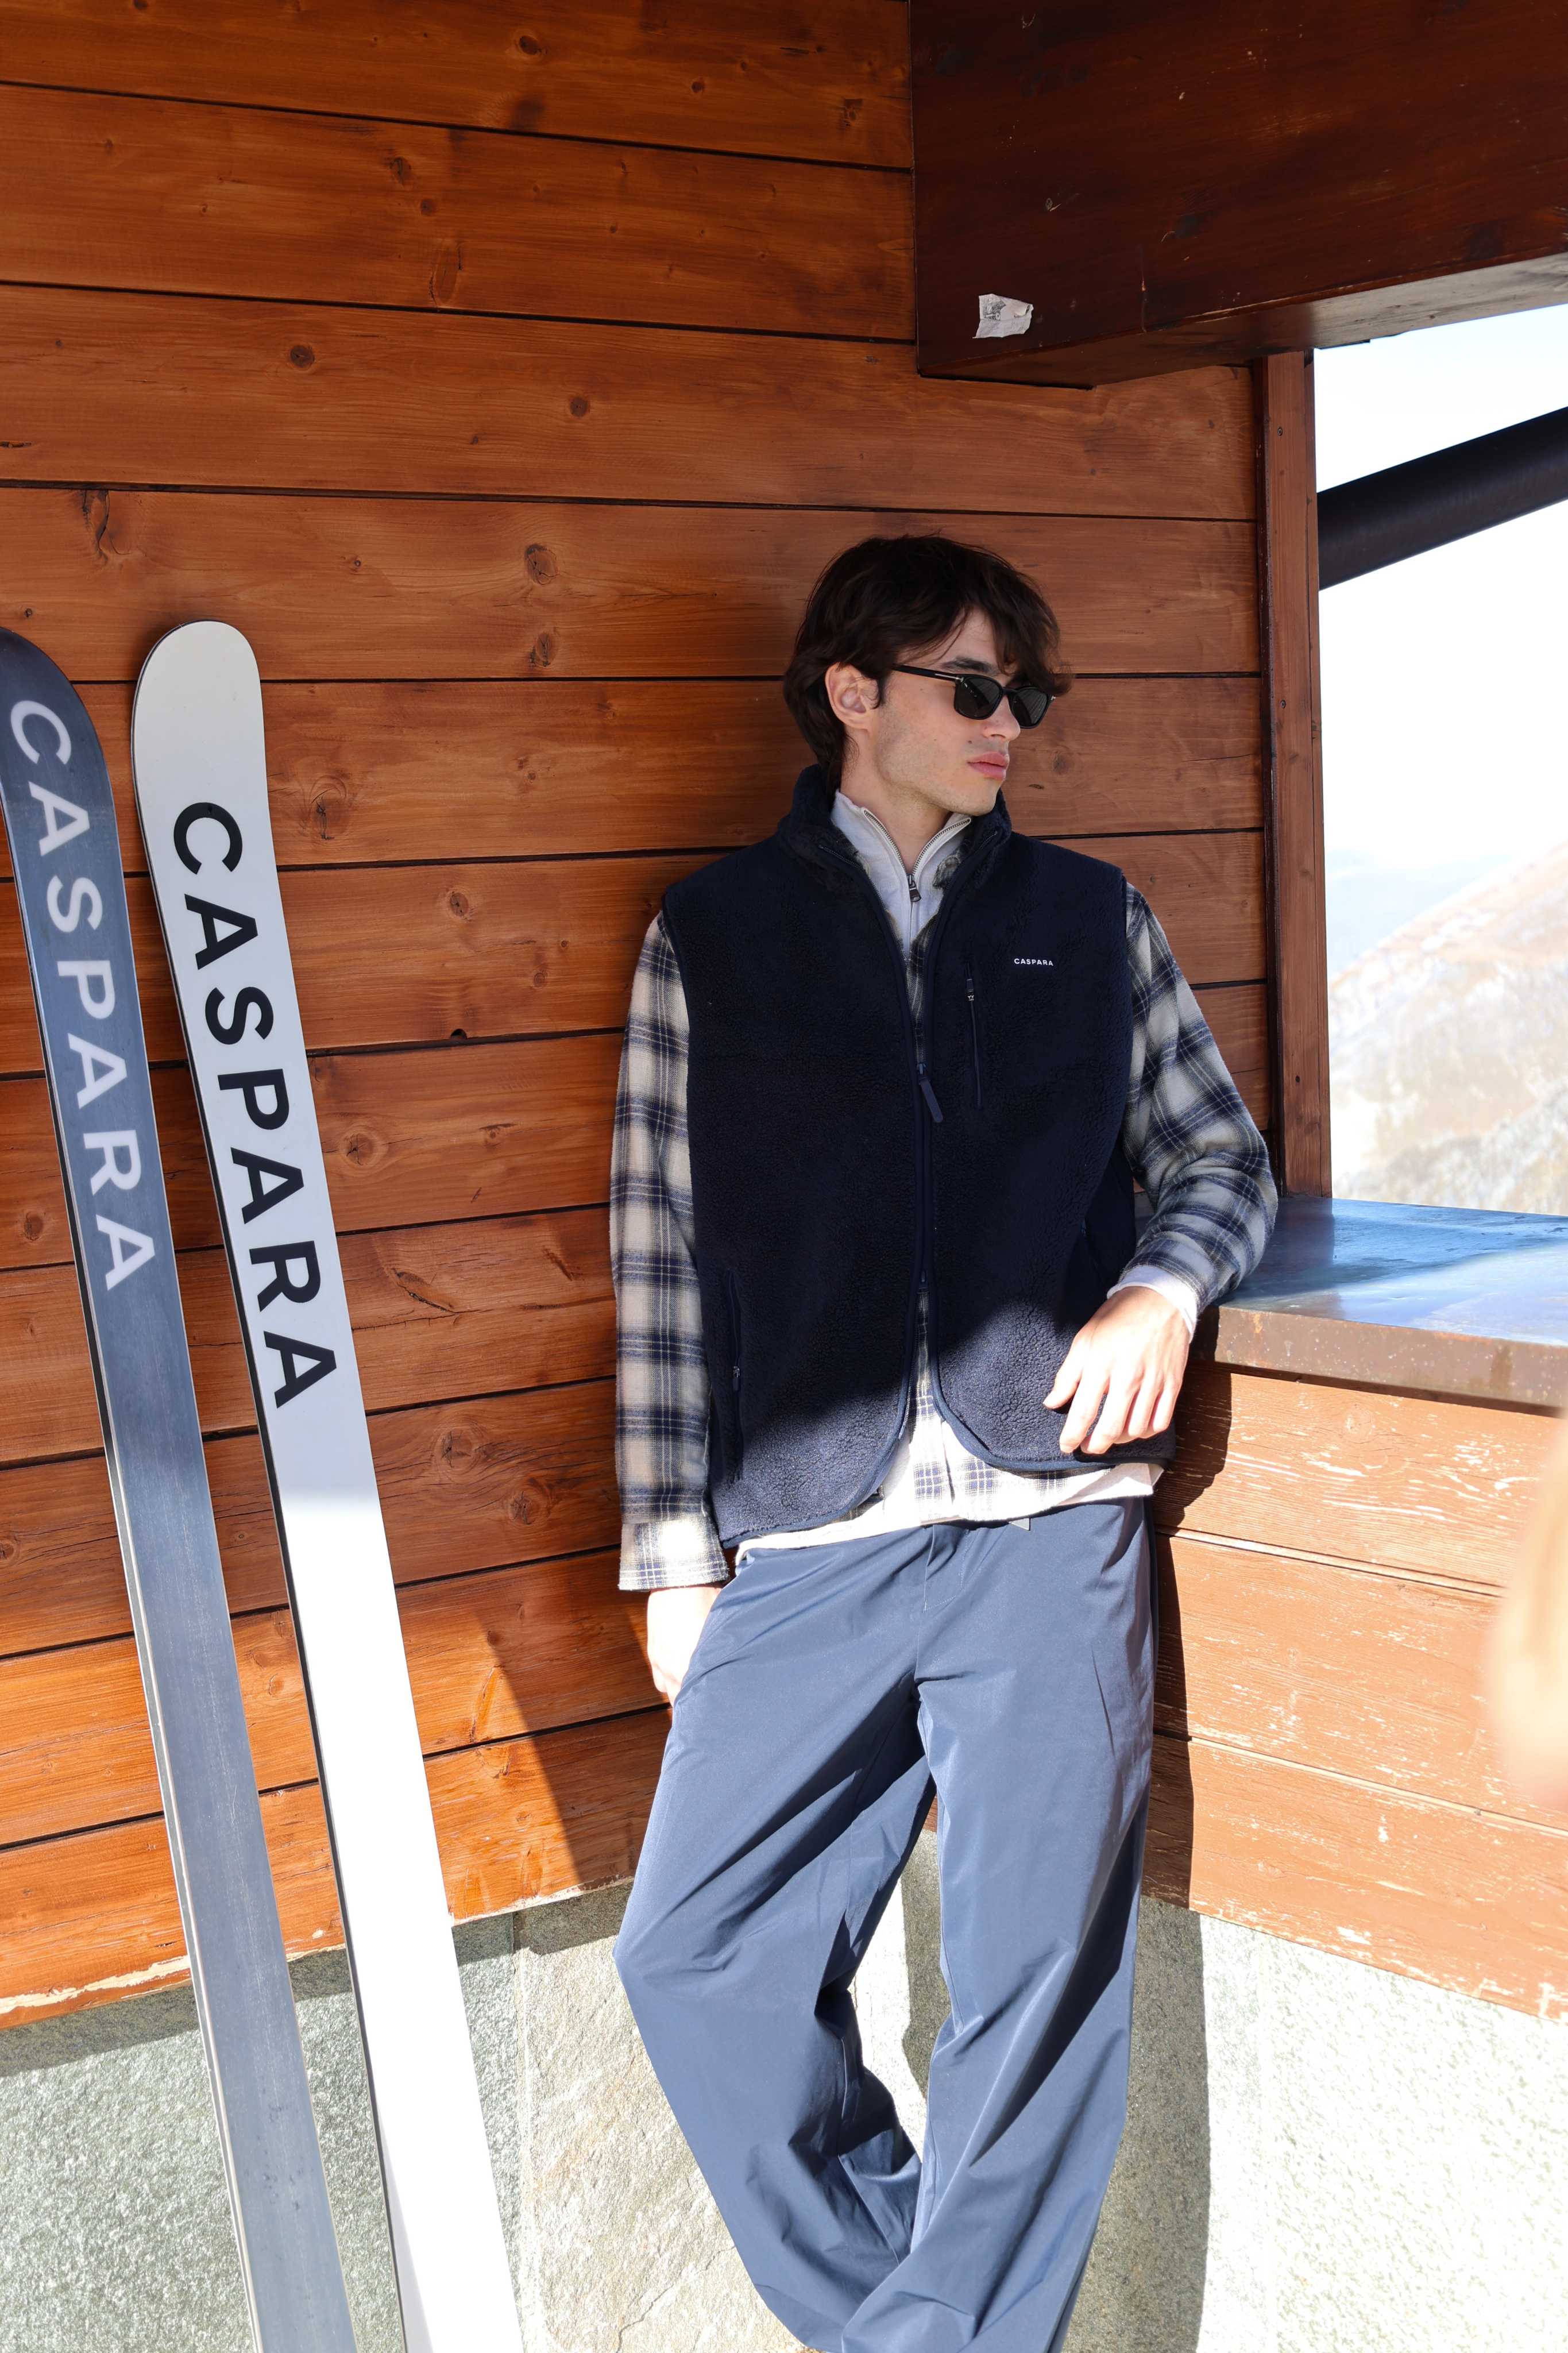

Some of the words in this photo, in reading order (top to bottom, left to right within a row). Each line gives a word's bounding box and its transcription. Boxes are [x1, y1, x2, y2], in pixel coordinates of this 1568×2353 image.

[10, 700, 155, 1291] CASPARA
[173, 802, 337, 1409] CASPARA
[1014, 958, 1053, 966] CASPARA
